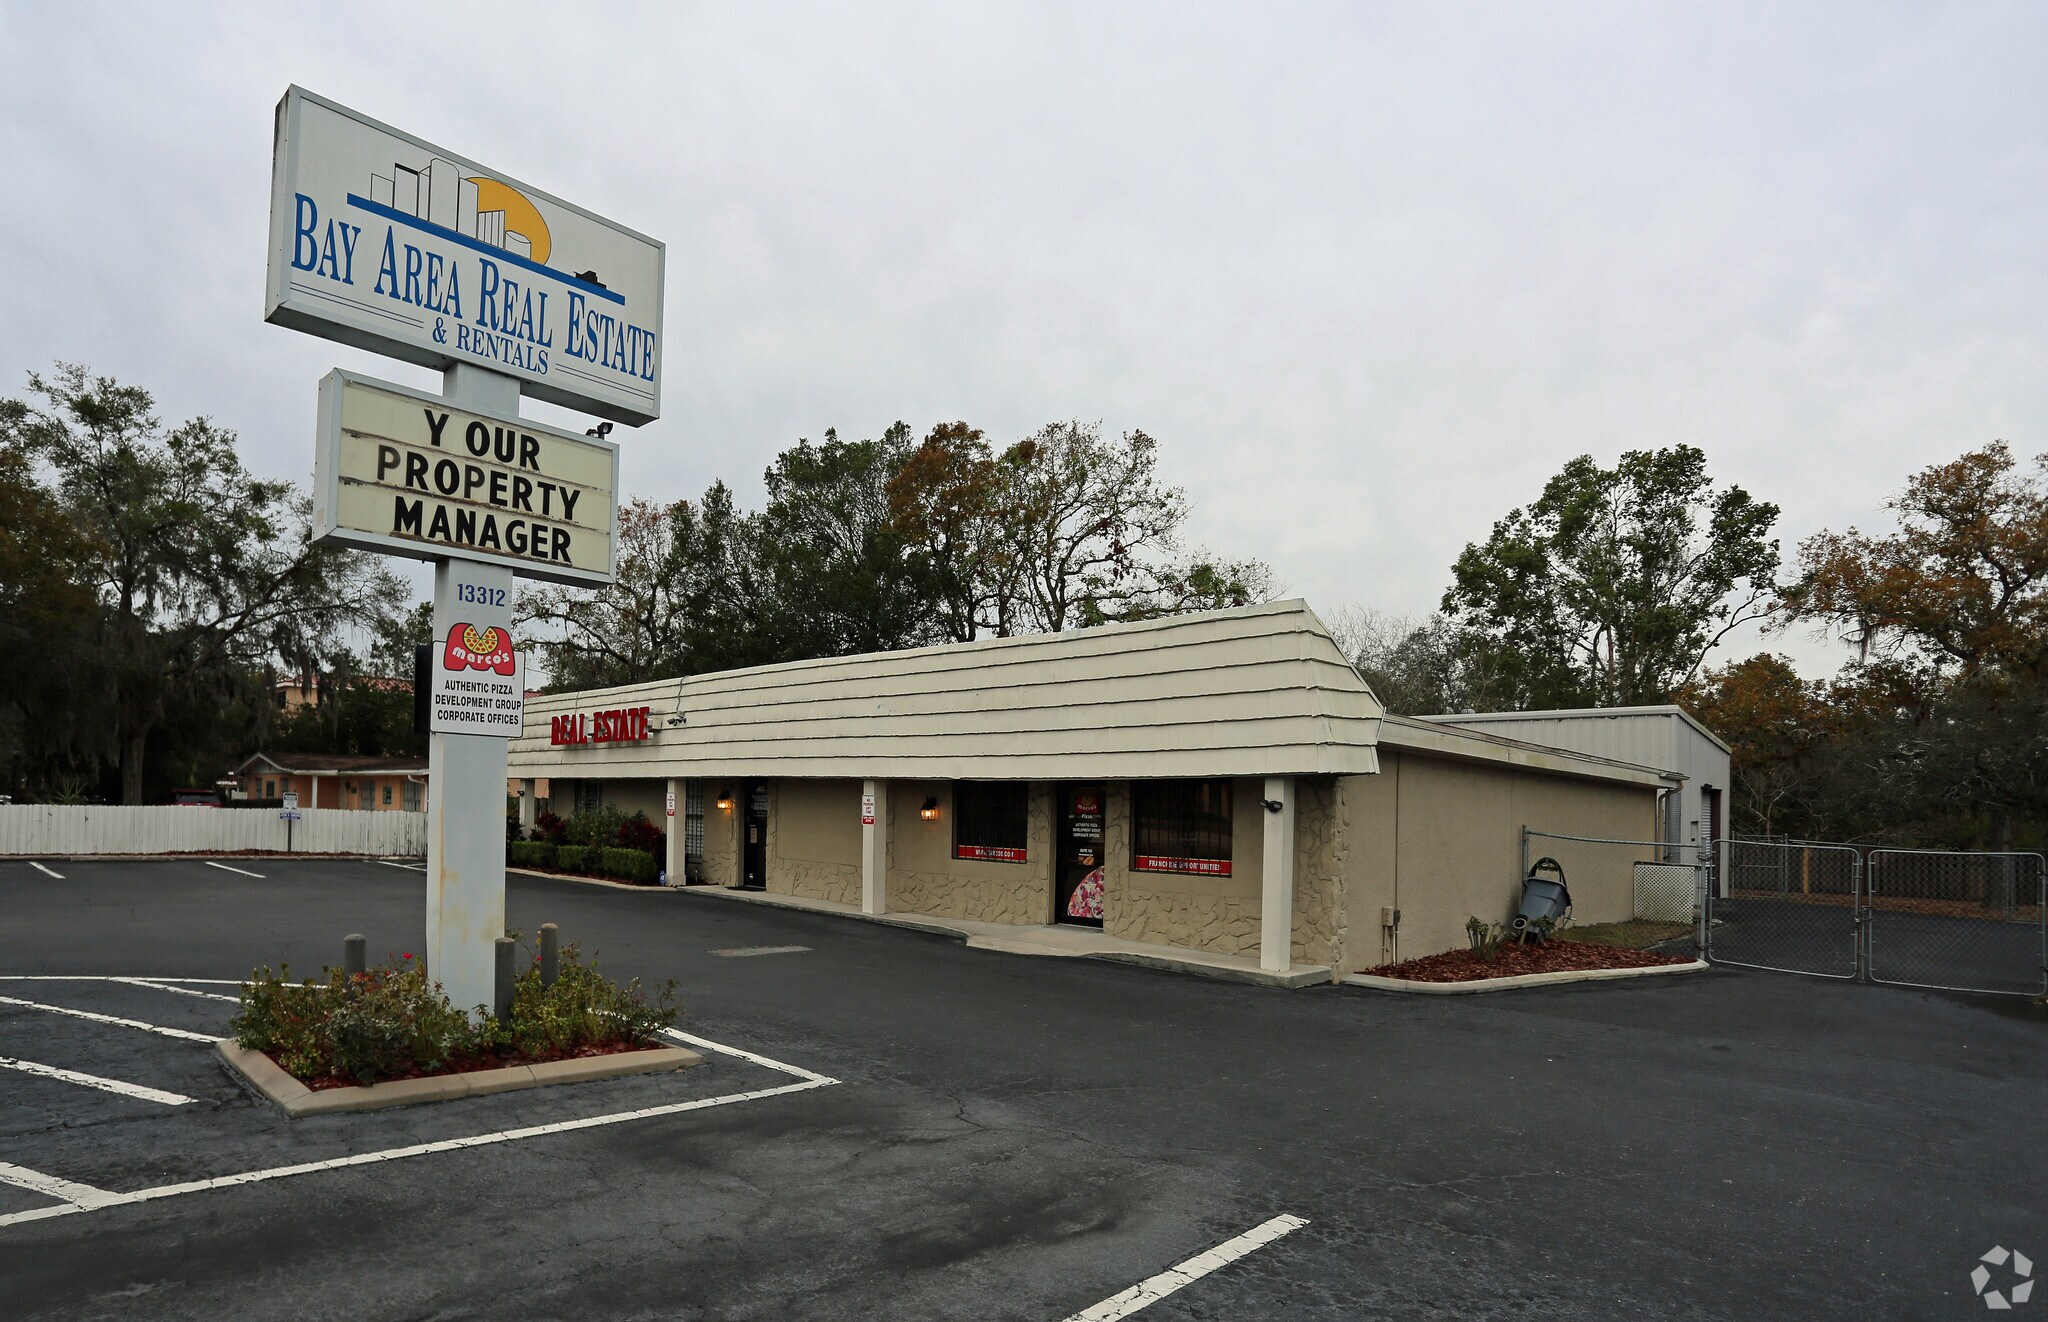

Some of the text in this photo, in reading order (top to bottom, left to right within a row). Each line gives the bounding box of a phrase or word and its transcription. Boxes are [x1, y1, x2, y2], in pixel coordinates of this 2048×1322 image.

[291, 192, 655, 382] BAY AREA REAL ESTATE
[432, 316, 549, 375] & RENTALS
[377, 444, 581, 520] PROPERTY
[394, 495, 571, 563] MANAGER
[457, 583, 506, 607] 13312
[435, 694, 521, 710] DEVELOPMENT GROUP
[444, 680, 513, 695] AUTHENTIC PIZZA
[437, 709, 519, 725] CORPORATE OFFICES
[551, 706, 650, 745] REAL ESTATE
